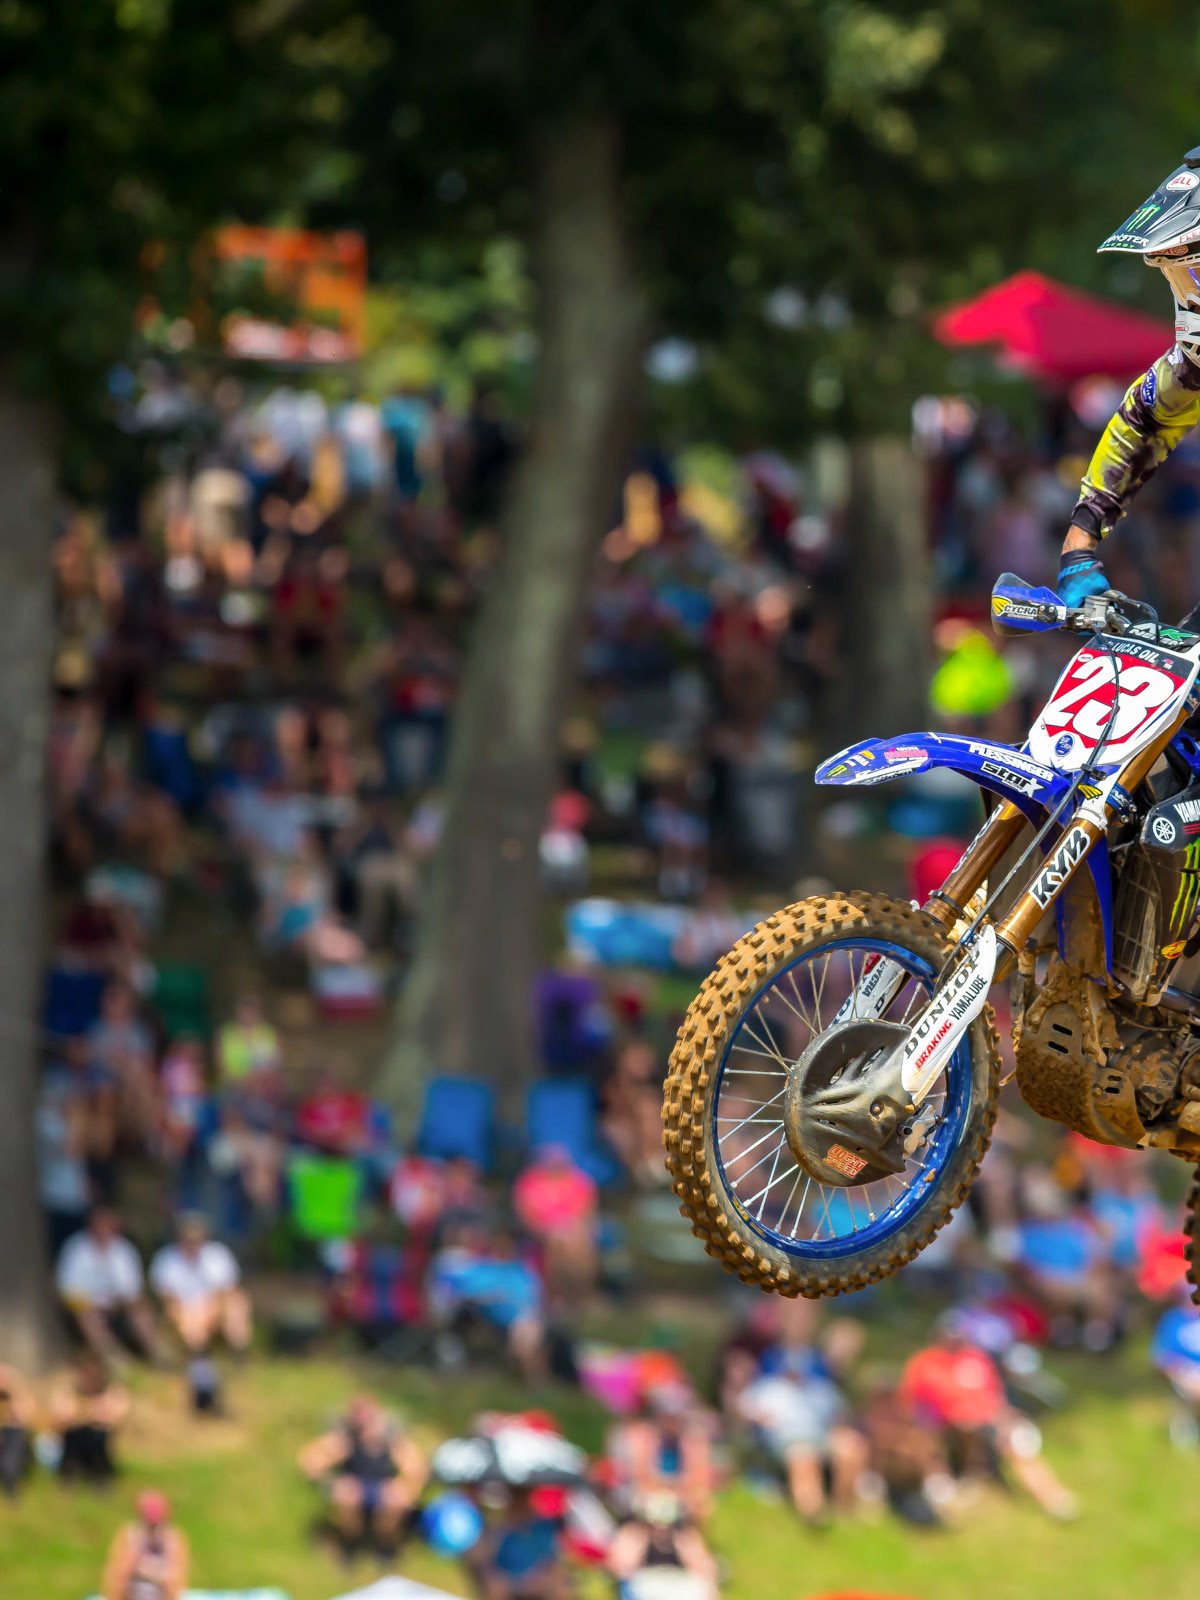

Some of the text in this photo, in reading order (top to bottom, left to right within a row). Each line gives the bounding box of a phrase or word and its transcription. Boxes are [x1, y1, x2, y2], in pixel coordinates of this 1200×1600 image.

[1004, 604, 1038, 616] CYCRA
[1111, 642, 1161, 663] LUCAS OIL
[1043, 655, 1176, 742] 23
[968, 743, 1055, 783] PLESSINGER
[1028, 826, 1091, 911] KYB
[903, 952, 980, 1060] DUNLOP
[914, 974, 988, 1070] BRAKING YAMALUBE
[829, 1147, 866, 1170] LIGHT
